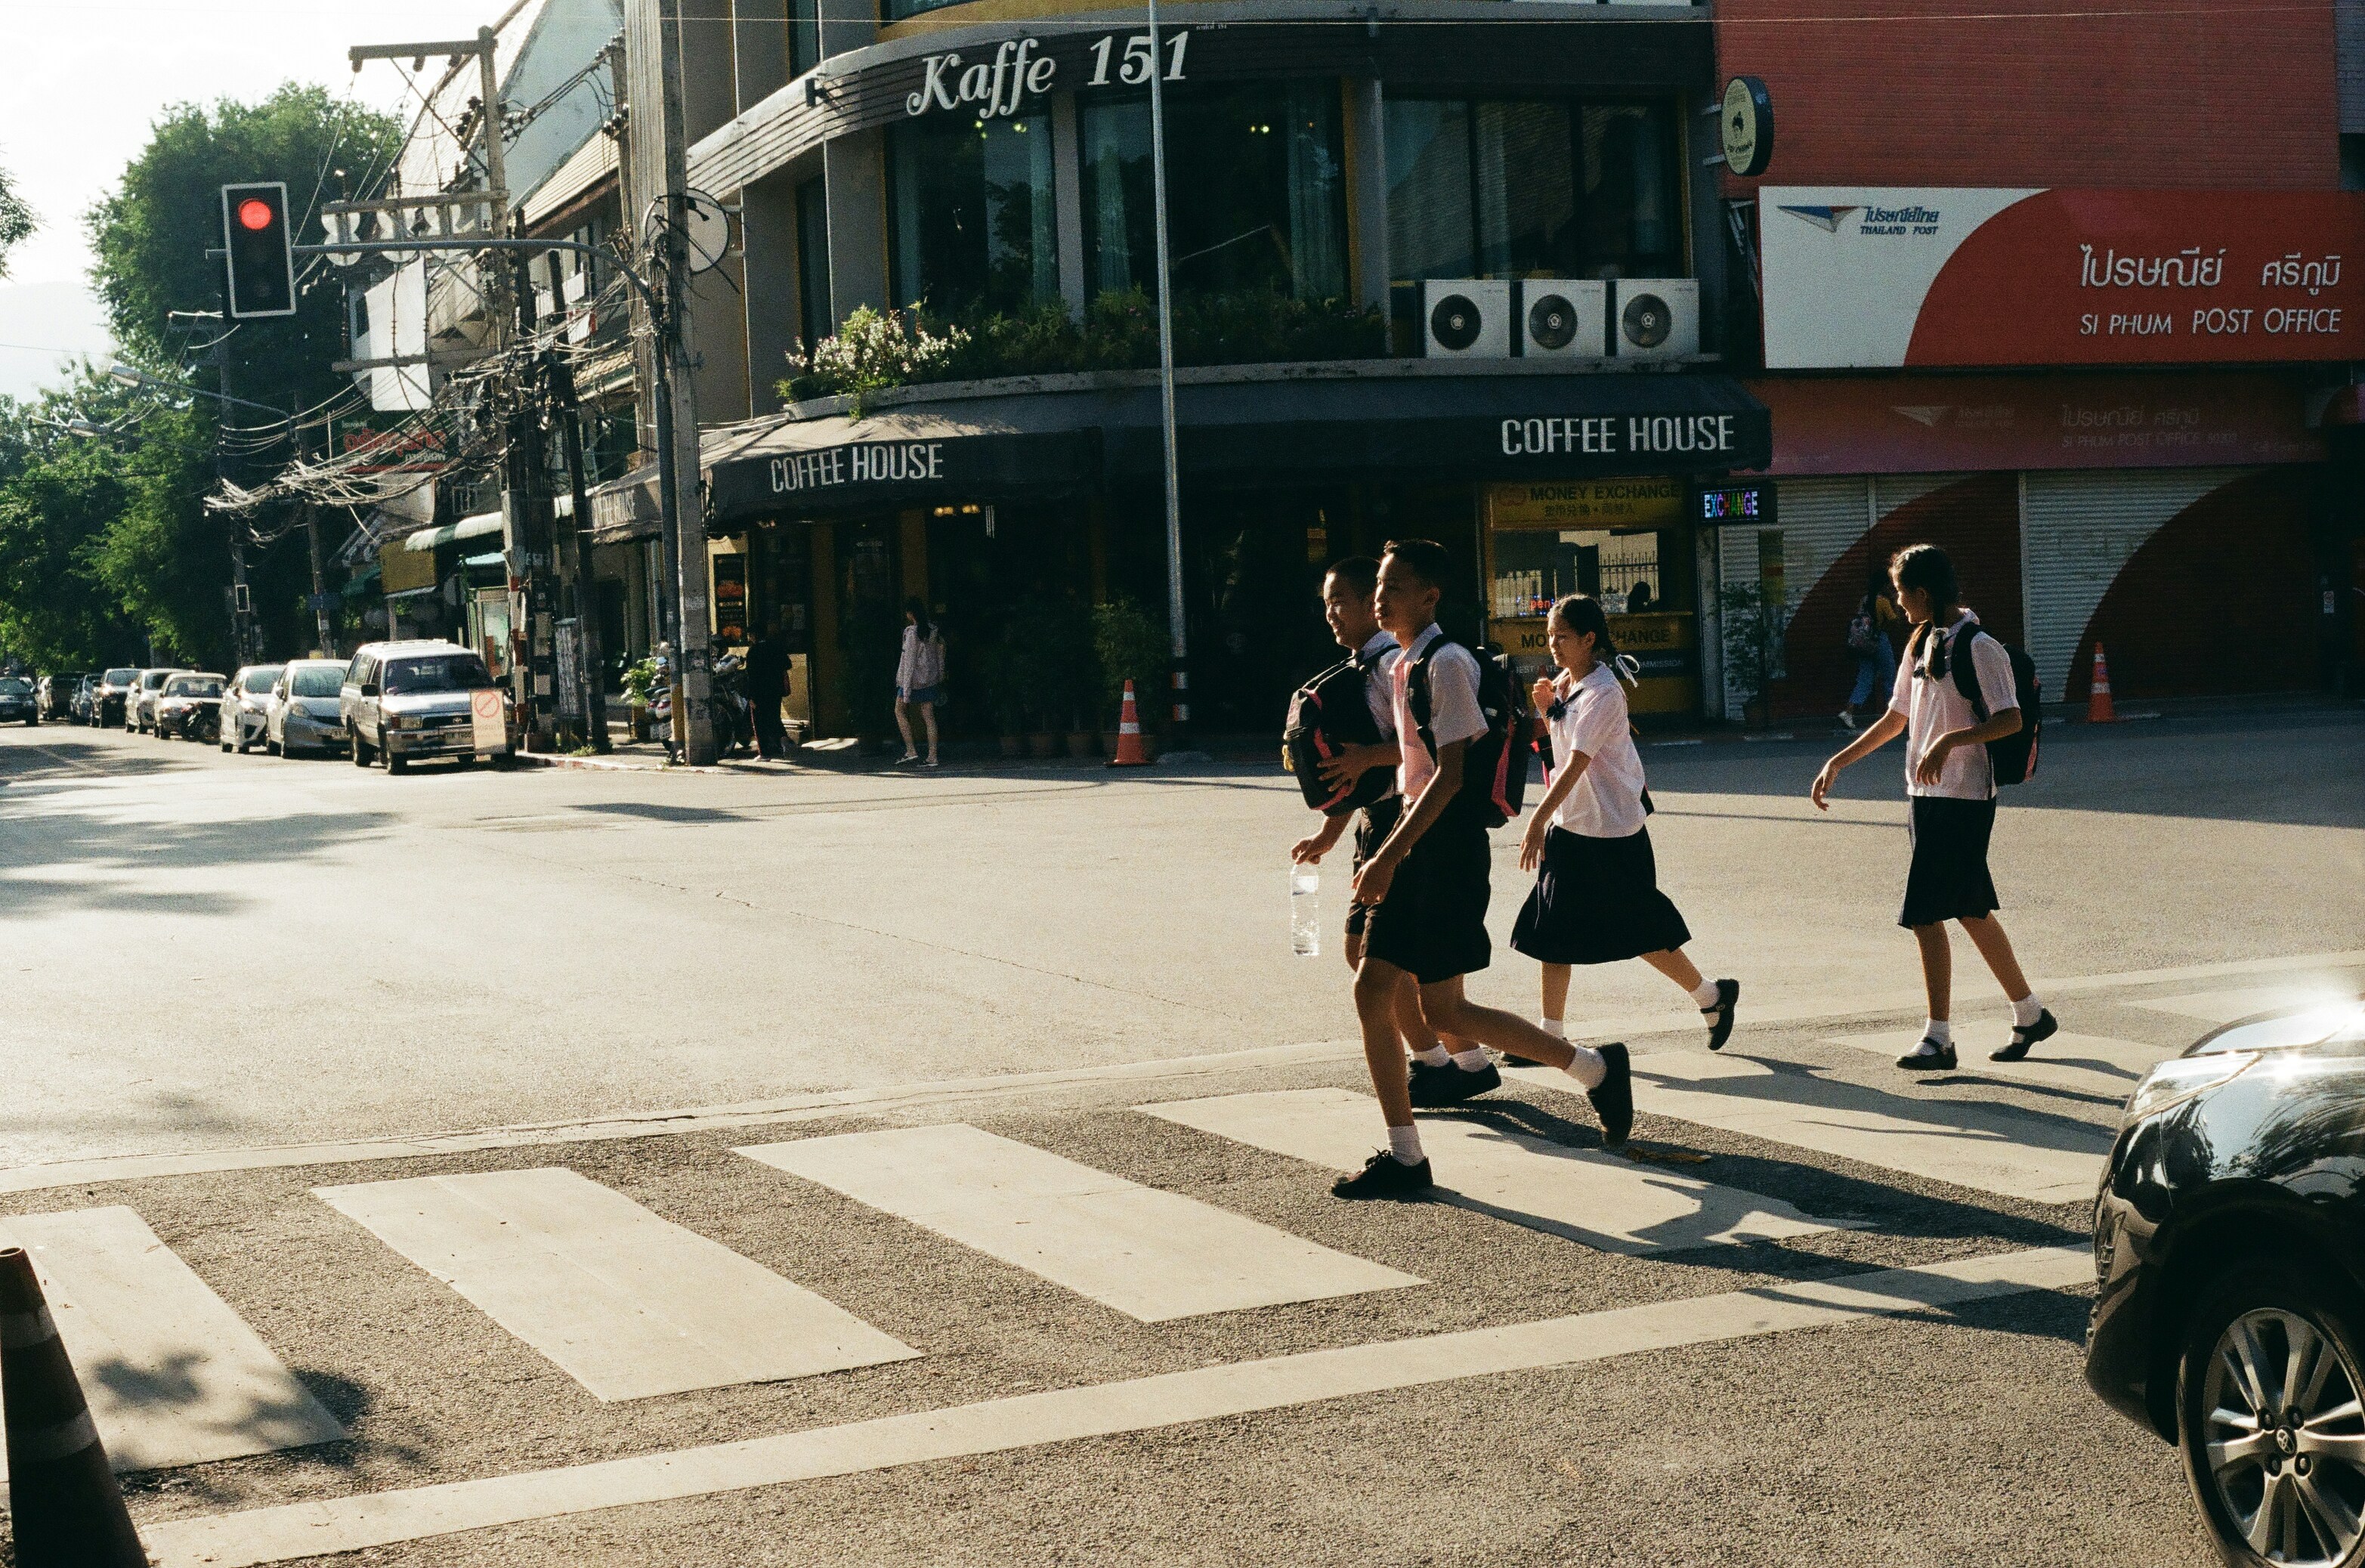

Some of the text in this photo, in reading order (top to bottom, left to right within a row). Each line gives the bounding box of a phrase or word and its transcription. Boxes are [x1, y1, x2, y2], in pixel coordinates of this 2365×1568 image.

[906, 31, 1189, 119] Kaffe 151
[1860, 225, 1939, 235] THAILAND POST
[2079, 244, 2341, 296] ไปรษณีย์ ศรีภูมิ
[2080, 308, 2342, 335] SI PHUM POST OFFICE
[2062, 404, 2145, 428] ไปรษณีย์
[1501, 415, 1735, 455] COFFEE HOUSE
[2078, 435, 2114, 447] PHUM
[2118, 432, 2153, 447] POST
[2156, 430, 2200, 446] OFFICE
[771, 444, 943, 493] COFFEE HOUSE
[1531, 484, 1680, 501] MONEY EXCHANGE
[1704, 491, 1758, 518] EXCHANGE
[1610, 628, 1671, 645] CHANGE
